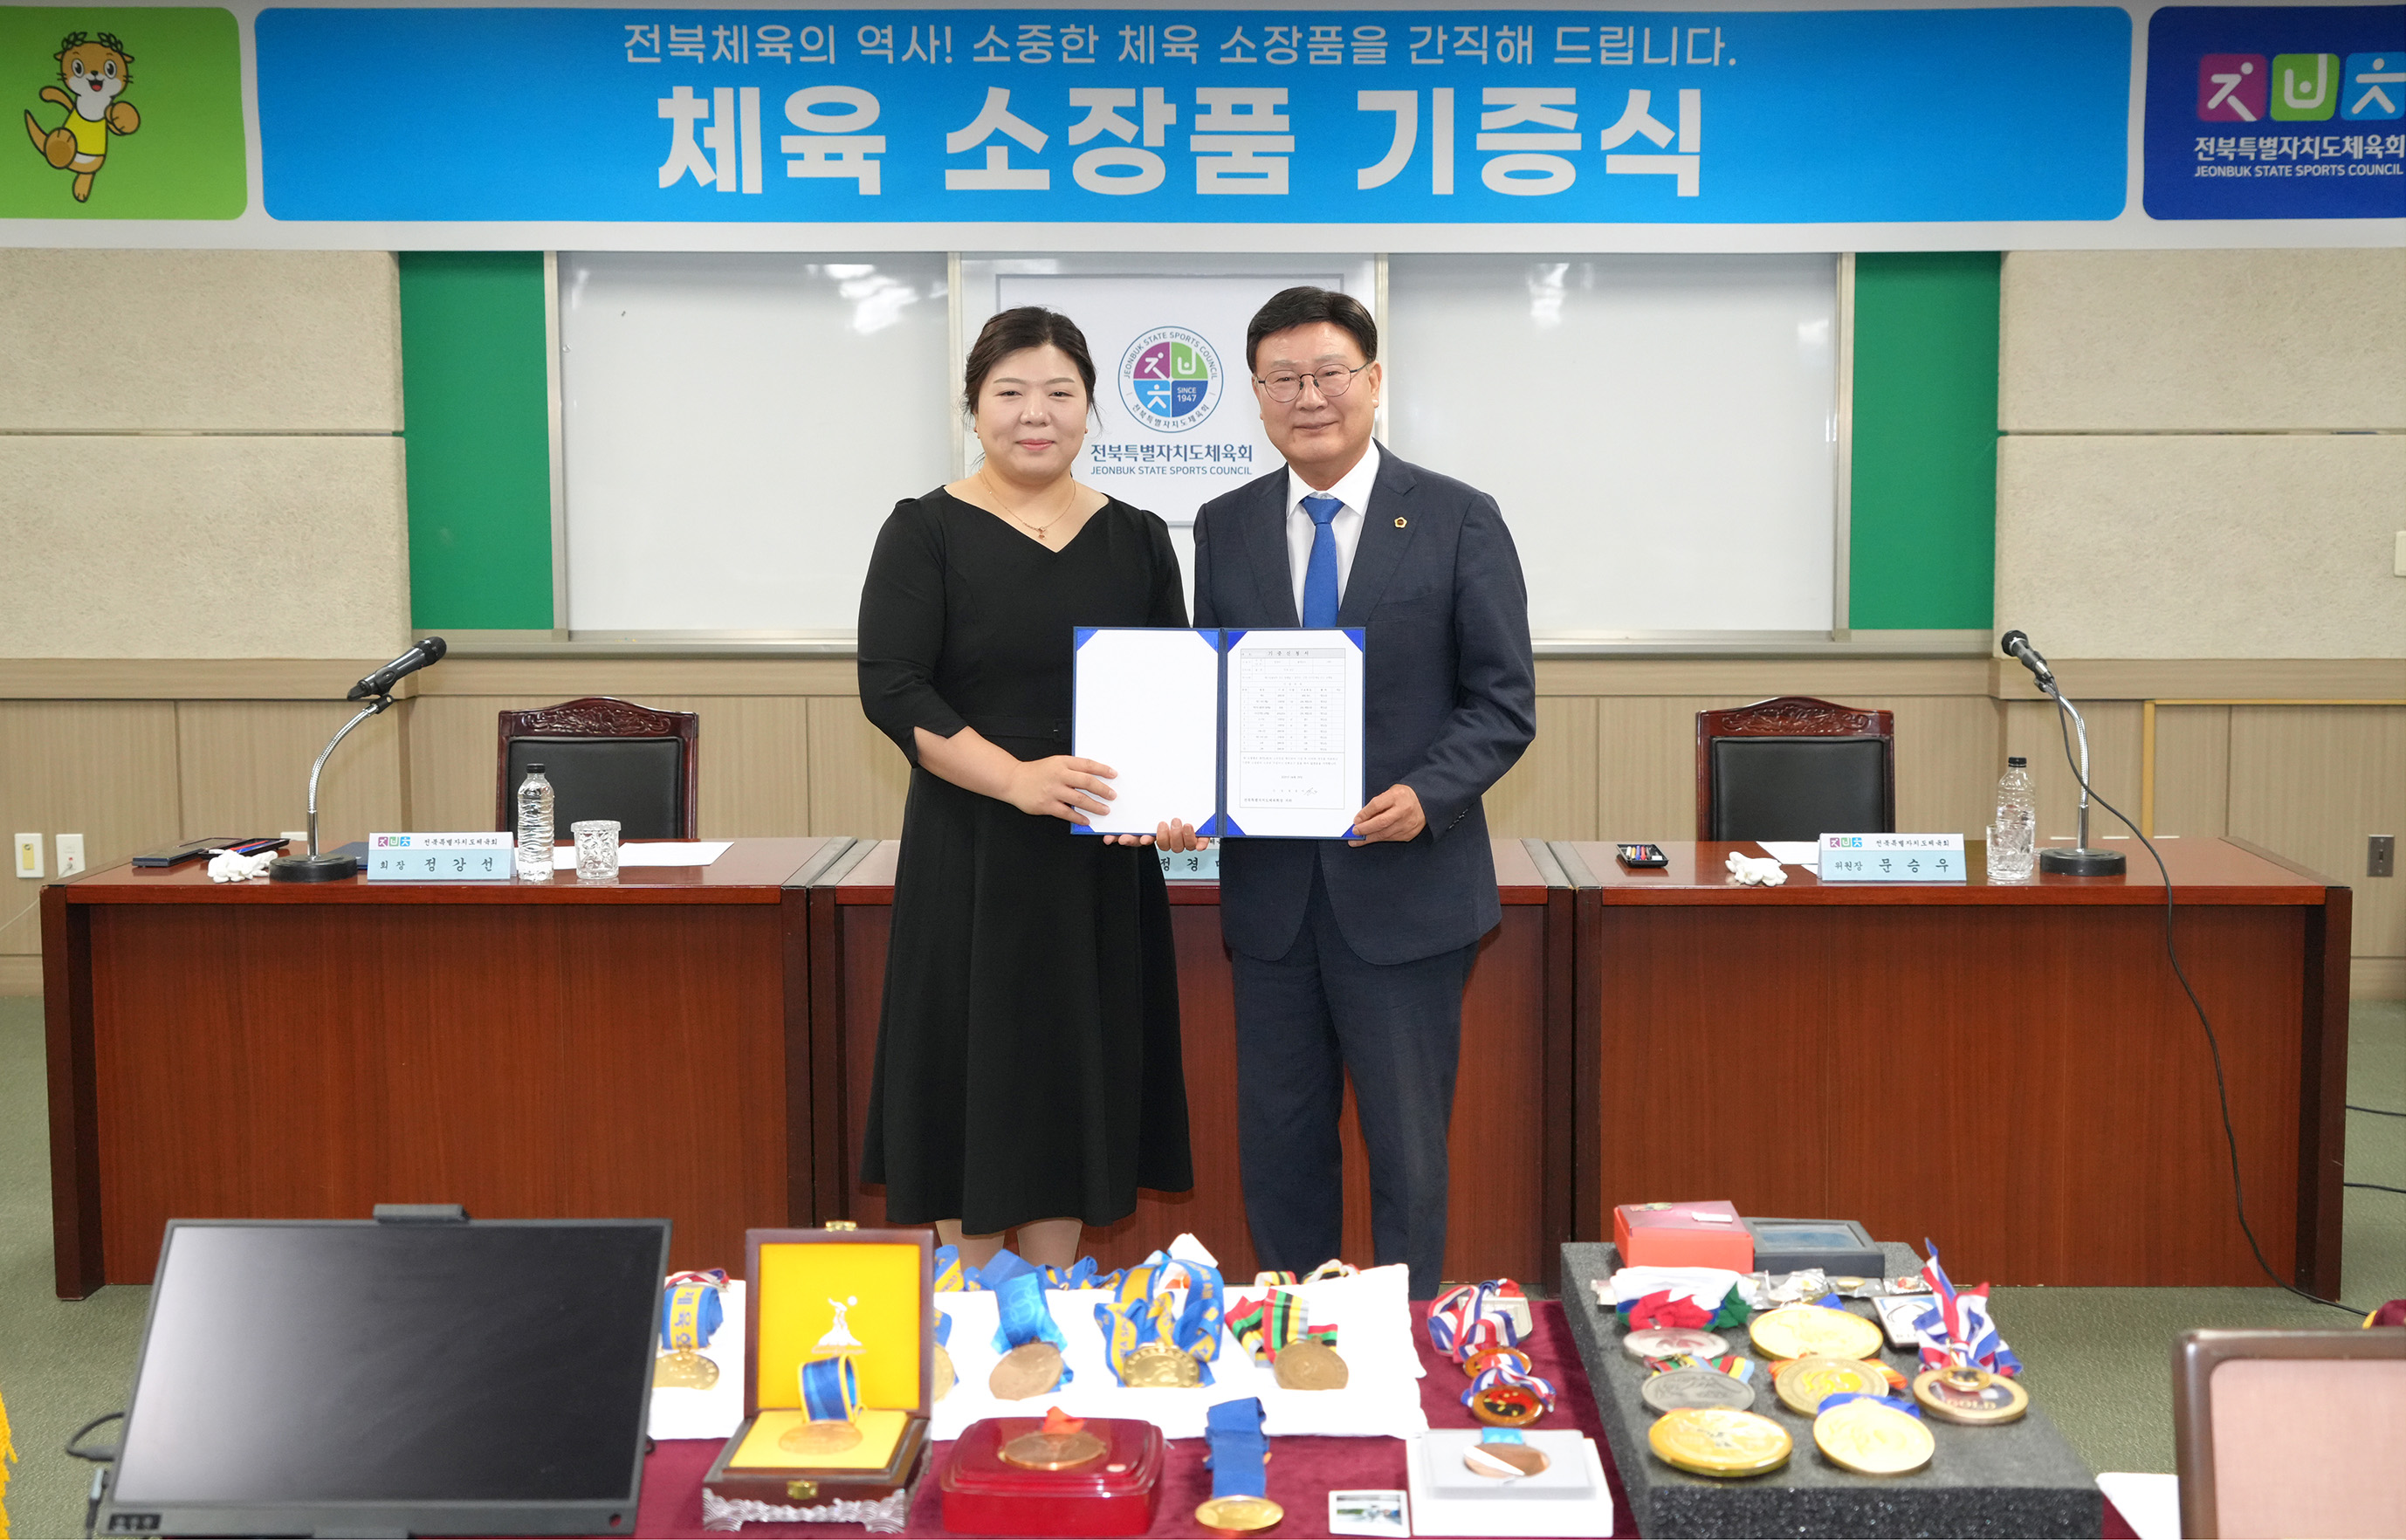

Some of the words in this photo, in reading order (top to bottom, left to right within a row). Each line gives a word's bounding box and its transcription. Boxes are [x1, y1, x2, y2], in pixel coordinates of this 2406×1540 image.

[624, 24, 835, 65] 전북체육의
[857, 24, 952, 64] 역사!
[973, 24, 1099, 64] 소중한
[1118, 24, 1200, 65] 체육
[1220, 25, 1388, 65] 소장품을
[1410, 24, 1533, 65] 간직해
[1554, 26, 1736, 66] 드립니다.
[657, 85, 887, 196] 체육
[945, 86, 1296, 196] 소장품
[1357, 87, 1701, 197] 기증식
[2194, 134, 2406, 161] 전북특별자치도체육회
[2195, 165, 2252, 177] JEONBUK
[2254, 165, 2293, 177] STATE
[2295, 164, 2346, 176] SPORTS
[2348, 163, 2404, 176] COUNCIL
[1124, 344, 1144, 379] JEONBUK
[1143, 331, 1168, 347] STATE
[1170, 331, 1200, 348] SPORTS
[1199, 346, 1219, 381] COUNCIL
[1177, 394, 1197, 402] 1947
[1090, 443, 1253, 463] 전북특별자치도체육회
[1090, 466, 1136, 475] JEONBUK
[1138, 466, 1166, 475] STATE
[1169, 466, 1207, 475] SPORTS
[1209, 466, 1253, 475] COUNCIL
[1834, 860, 1863, 871] 위원장
